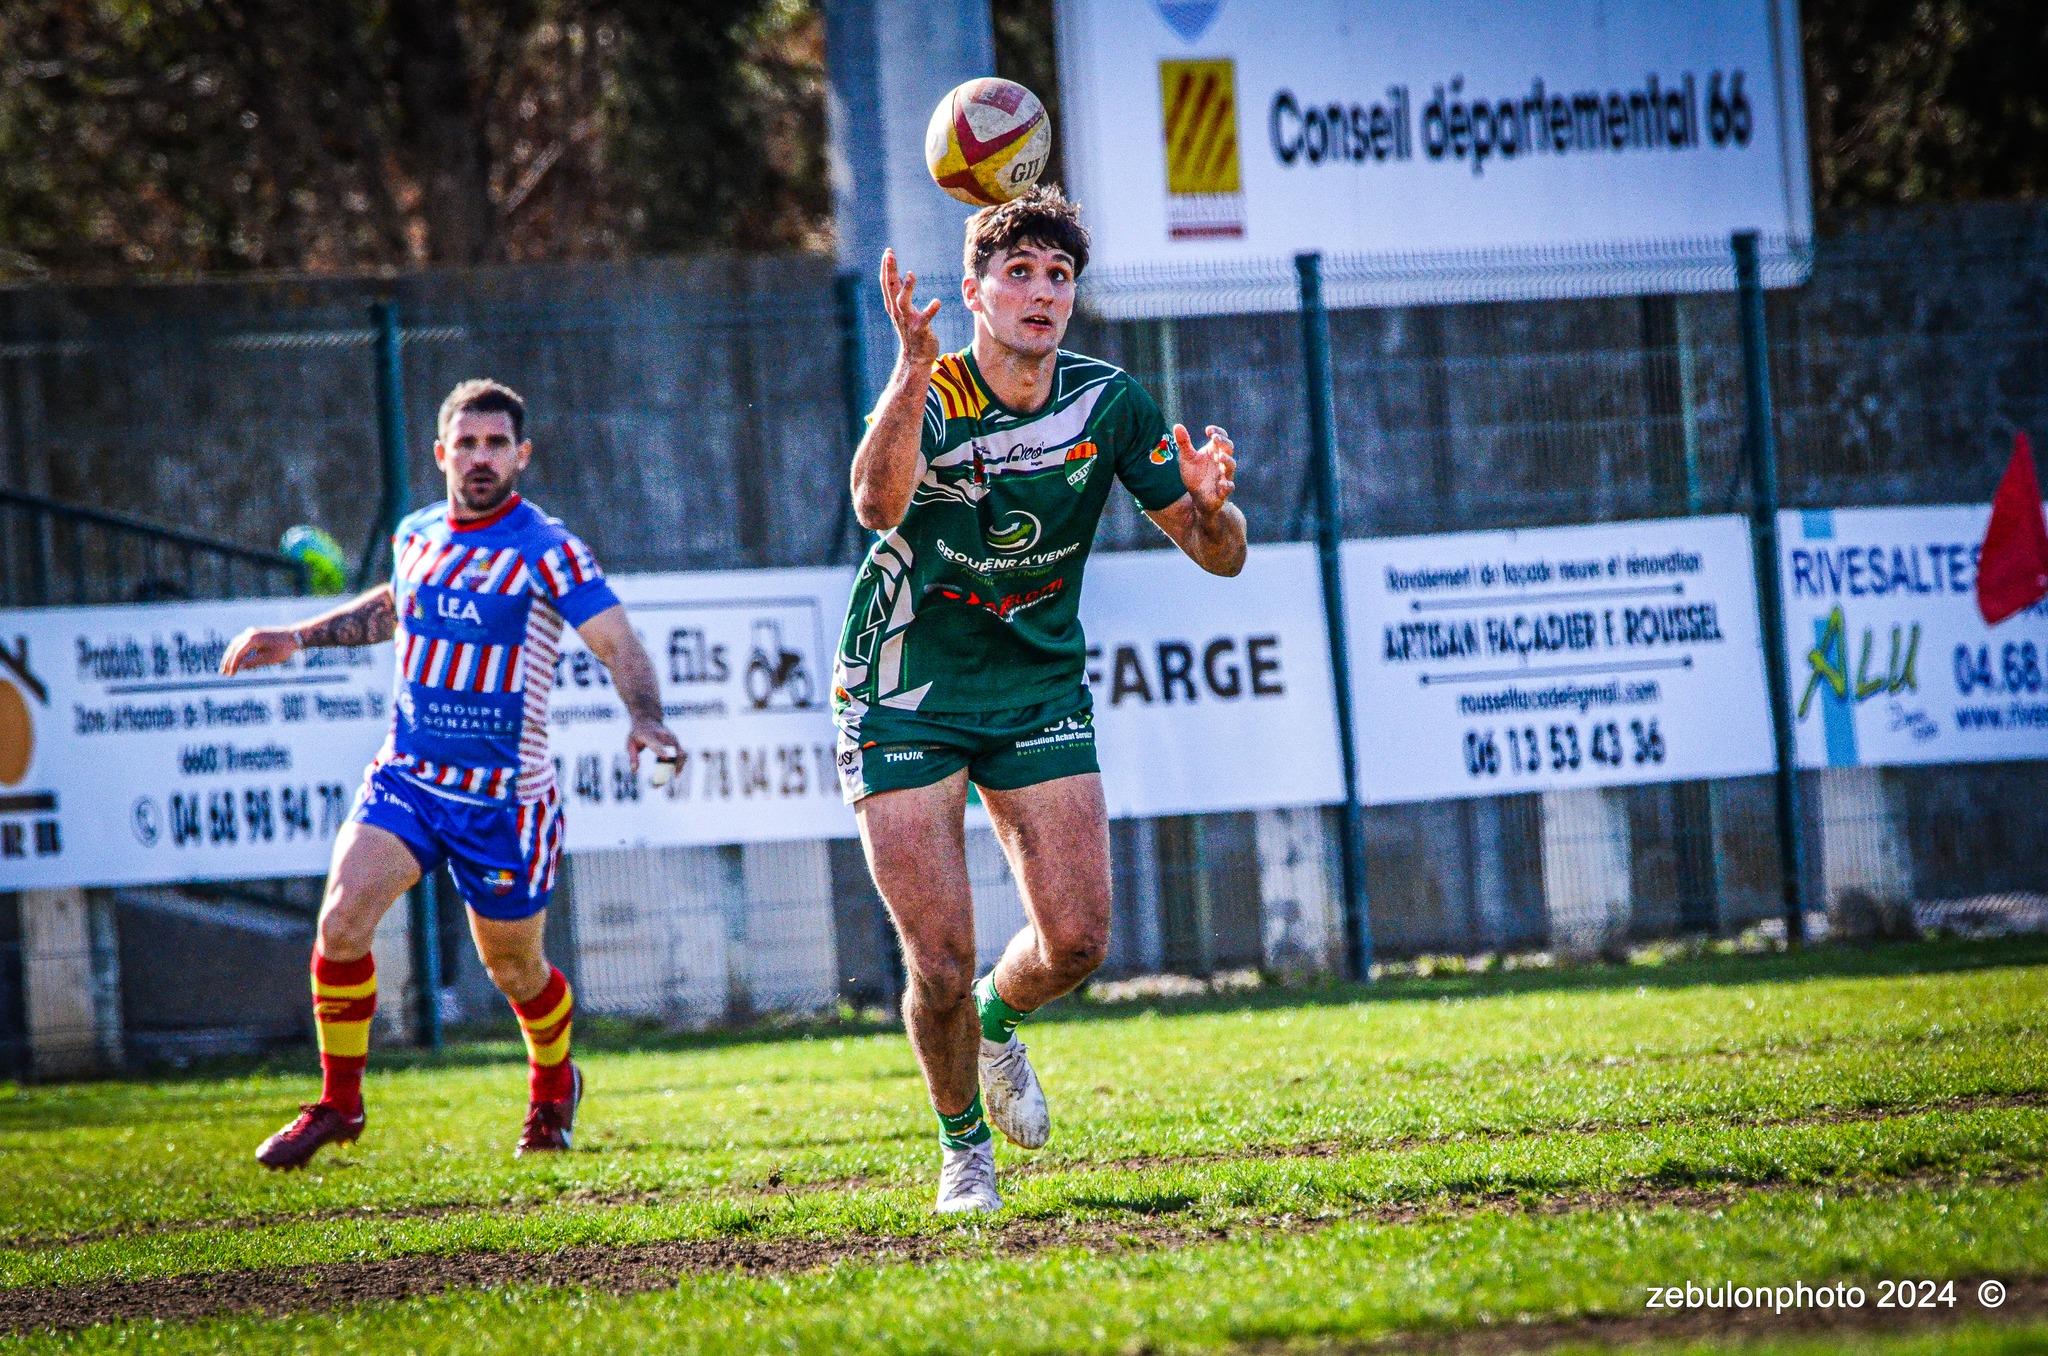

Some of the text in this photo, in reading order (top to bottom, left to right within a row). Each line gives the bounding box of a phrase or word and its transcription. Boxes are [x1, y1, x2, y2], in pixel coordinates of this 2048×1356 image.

[1272, 70, 1753, 175] Conseil départemental 66
[1010, 155, 1044, 183] GIL
[1019, 541, 1080, 566] A'VENIR
[438, 594, 482, 625] LEA
[1382, 618, 1481, 662] ARTISAN
[1485, 608, 1597, 664] FAÇADIER
[1623, 602, 1725, 646] ROUSSEL
[668, 627, 730, 683] fils
[422, 715, 515, 732] GONZALEZ
[428, 701, 501, 718] GROUPE
[1015, 736, 1055, 748] Roussillon
[1055, 732, 1075, 742] Achat
[1463, 714, 1667, 777] 06 13 53 43 36
[884, 751, 924, 763] THUIR
[170, 791, 201, 848] 04
[208, 789, 238, 845] 68
